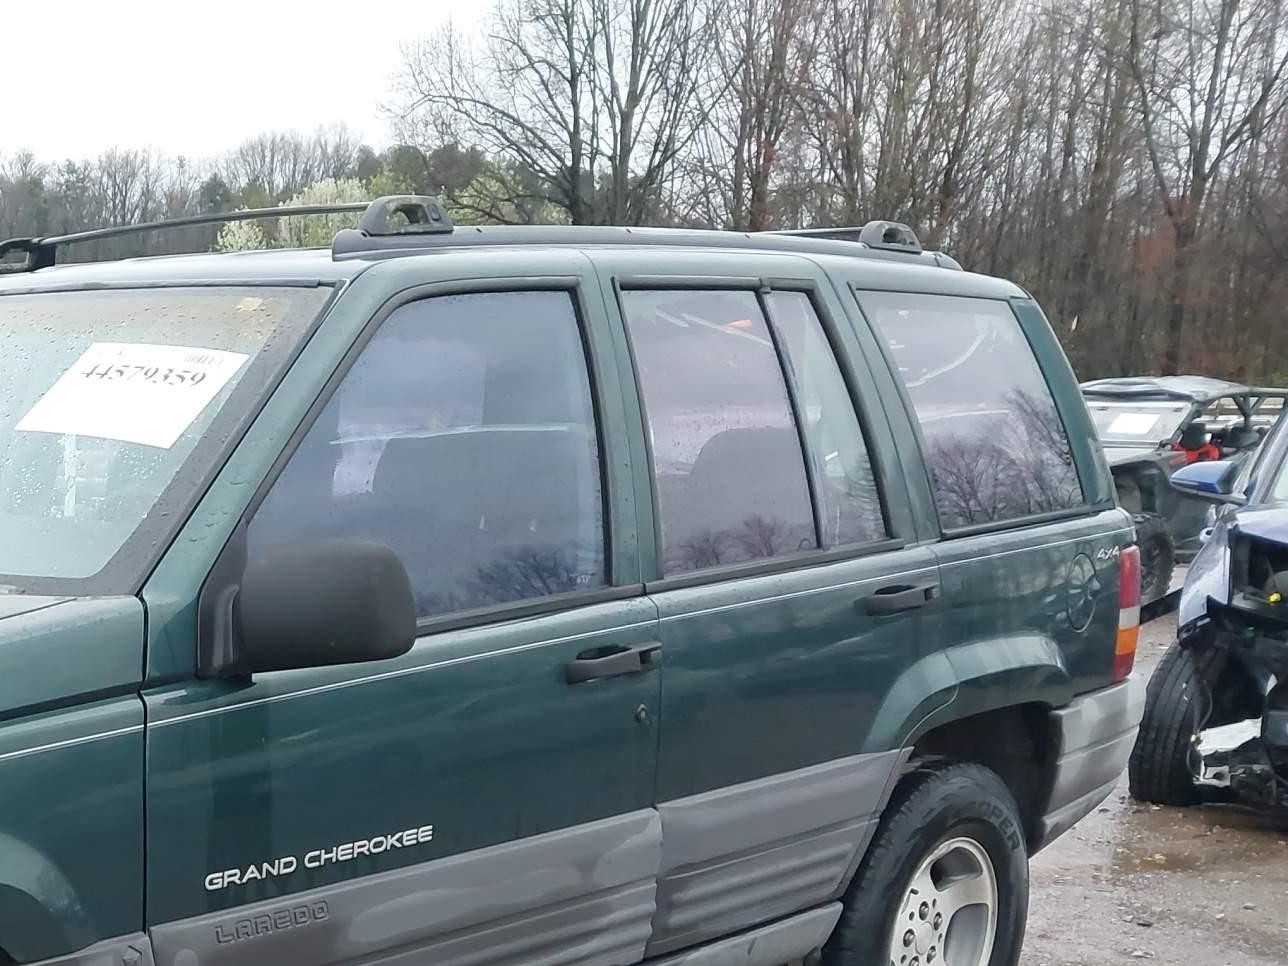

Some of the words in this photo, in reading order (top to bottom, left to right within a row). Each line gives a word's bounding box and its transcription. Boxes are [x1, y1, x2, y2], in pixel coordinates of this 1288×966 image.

[80, 362, 208, 388] 44579359
[204, 855, 299, 892] GRAND
[303, 824, 435, 869] CHEROKEE
[215, 899, 330, 945] LAREDO
